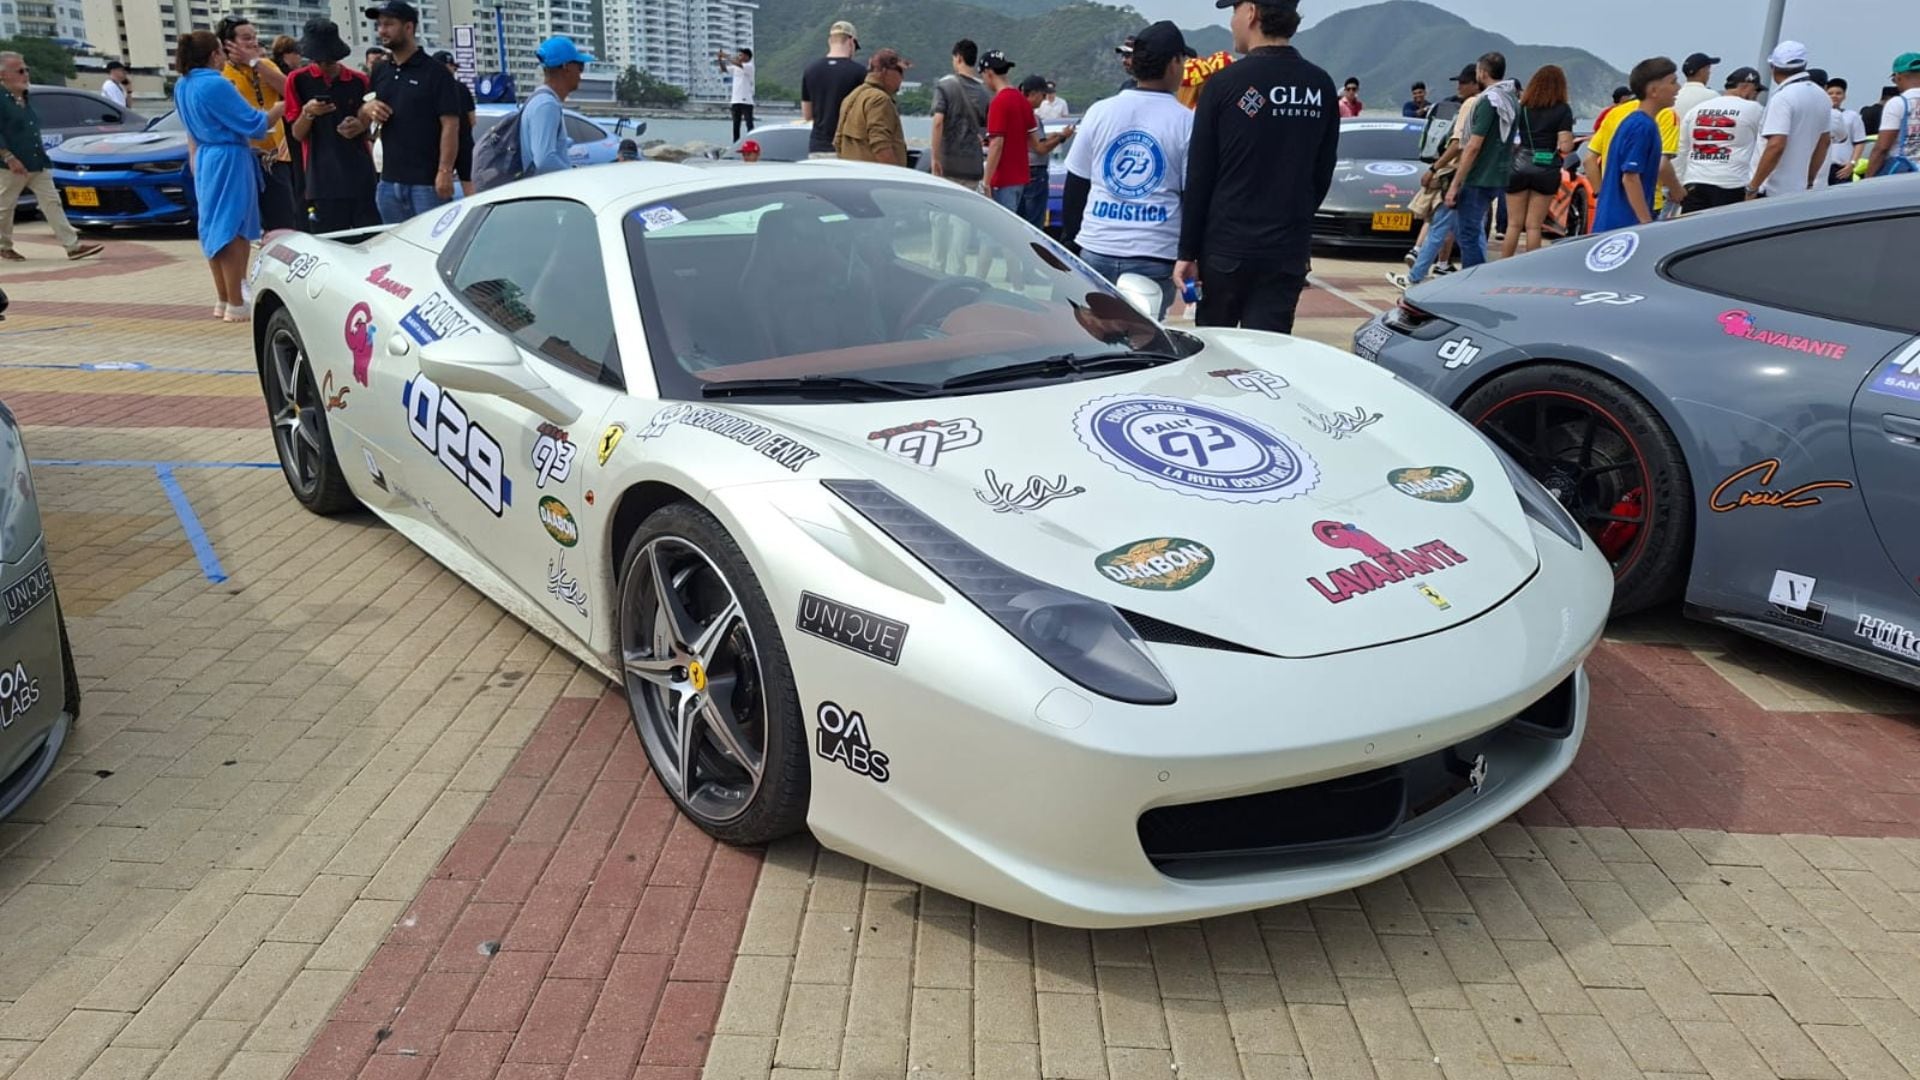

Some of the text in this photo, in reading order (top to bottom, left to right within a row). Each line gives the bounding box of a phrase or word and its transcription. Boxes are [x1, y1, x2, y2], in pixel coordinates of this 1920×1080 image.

[1269, 86, 1322, 106] GLM
[1272, 108, 1321, 118] EVENTOS
[1697, 108, 1740, 117] FERRARI
[1116, 156, 1150, 180] 93
[1690, 152, 1730, 161] FERRARI
[1092, 200, 1168, 222] LOGÍSTICA
[1574, 291, 1645, 306] 93
[1746, 328, 1848, 360] LAVAFANTE
[408, 372, 503, 517] 029
[681, 407, 820, 473] SEGURIDAD FENIX
[884, 417, 982, 467] 93
[1141, 418, 1193, 435] RALLY
[531, 433, 578, 488] 93
[1158, 426, 1236, 467] 93
[1162, 467, 1183, 479] LA
[1187, 474, 1229, 488] RUTA
[1102, 544, 1209, 580] DAABON
[1306, 539, 1468, 604] LAVAFANTE
[5, 565, 50, 611] UNIQUE
[804, 598, 899, 650] UNIQUE
[1, 678, 40, 728] LABS
[819, 704, 868, 746] OA
[819, 730, 888, 780] LABS
